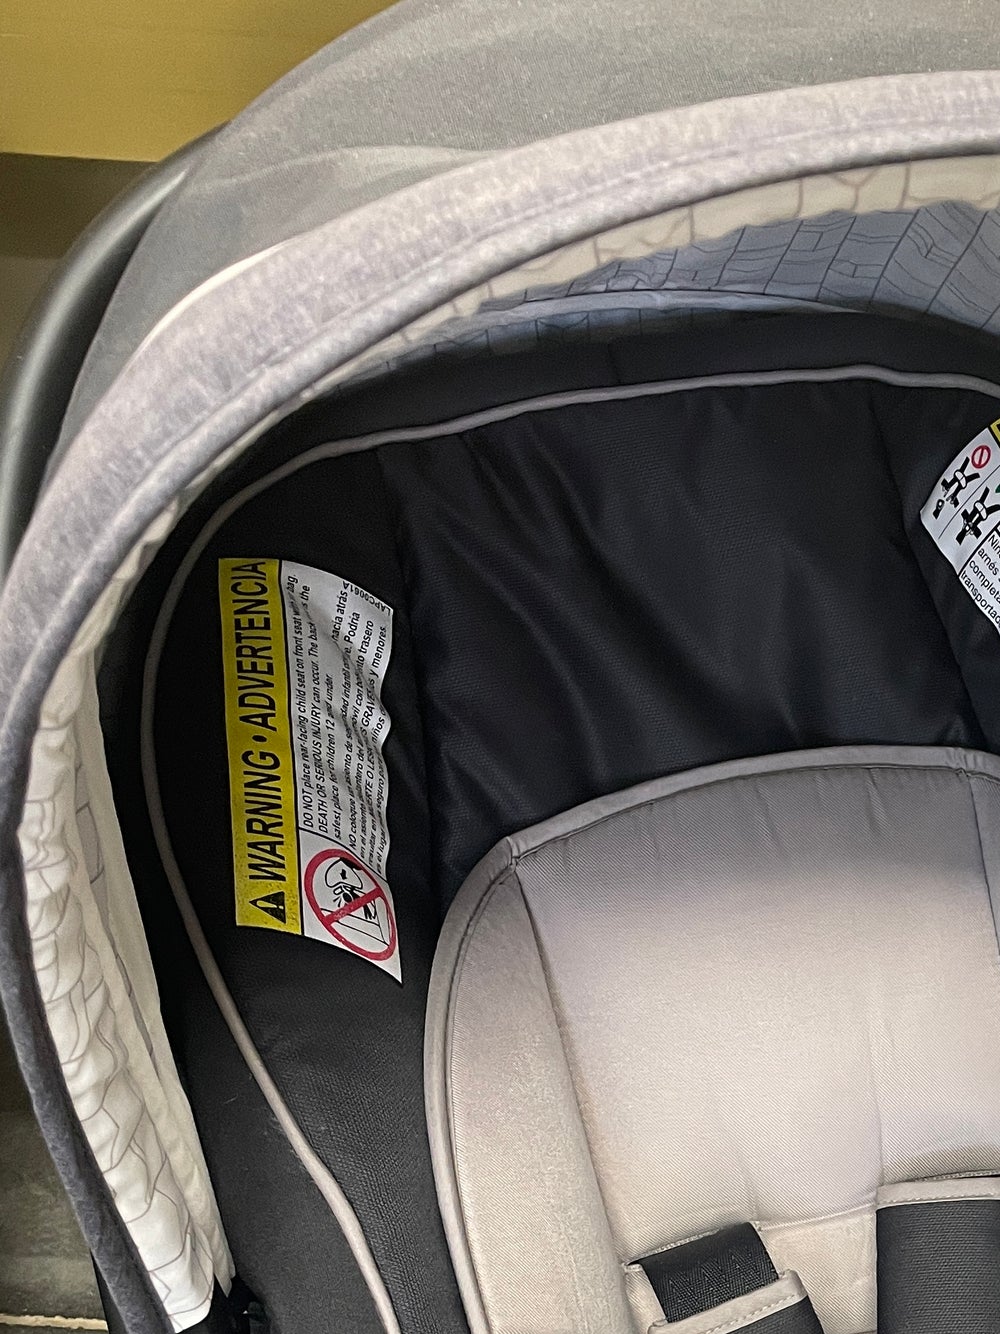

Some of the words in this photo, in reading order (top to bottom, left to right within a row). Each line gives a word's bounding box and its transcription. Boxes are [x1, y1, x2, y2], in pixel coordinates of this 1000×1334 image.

[299, 585, 310, 600] the
[336, 590, 348, 614] atrás
[293, 616, 302, 634] seat
[357, 619, 374, 653] trasero
[231, 561, 277, 731] ADVERTENCIA
[293, 636, 303, 656] front
[308, 642, 319, 656] The
[296, 658, 305, 668] on
[296, 669, 306, 687] seat
[295, 689, 306, 712] child
[311, 702, 322, 739] INJURY
[325, 718, 335, 730] 12
[312, 740, 325, 782] SERIOUS
[326, 733, 336, 770] children
[301, 763, 314, 788] place
[366, 770, 374, 779] O
[301, 788, 313, 810] NOT
[317, 783, 327, 797] OR
[331, 785, 343, 809] place
[241, 750, 286, 880] WARNING
[303, 812, 314, 827] DO
[318, 799, 328, 832] DEATH
[332, 810, 341, 839] safest
[349, 833, 357, 849] NO
